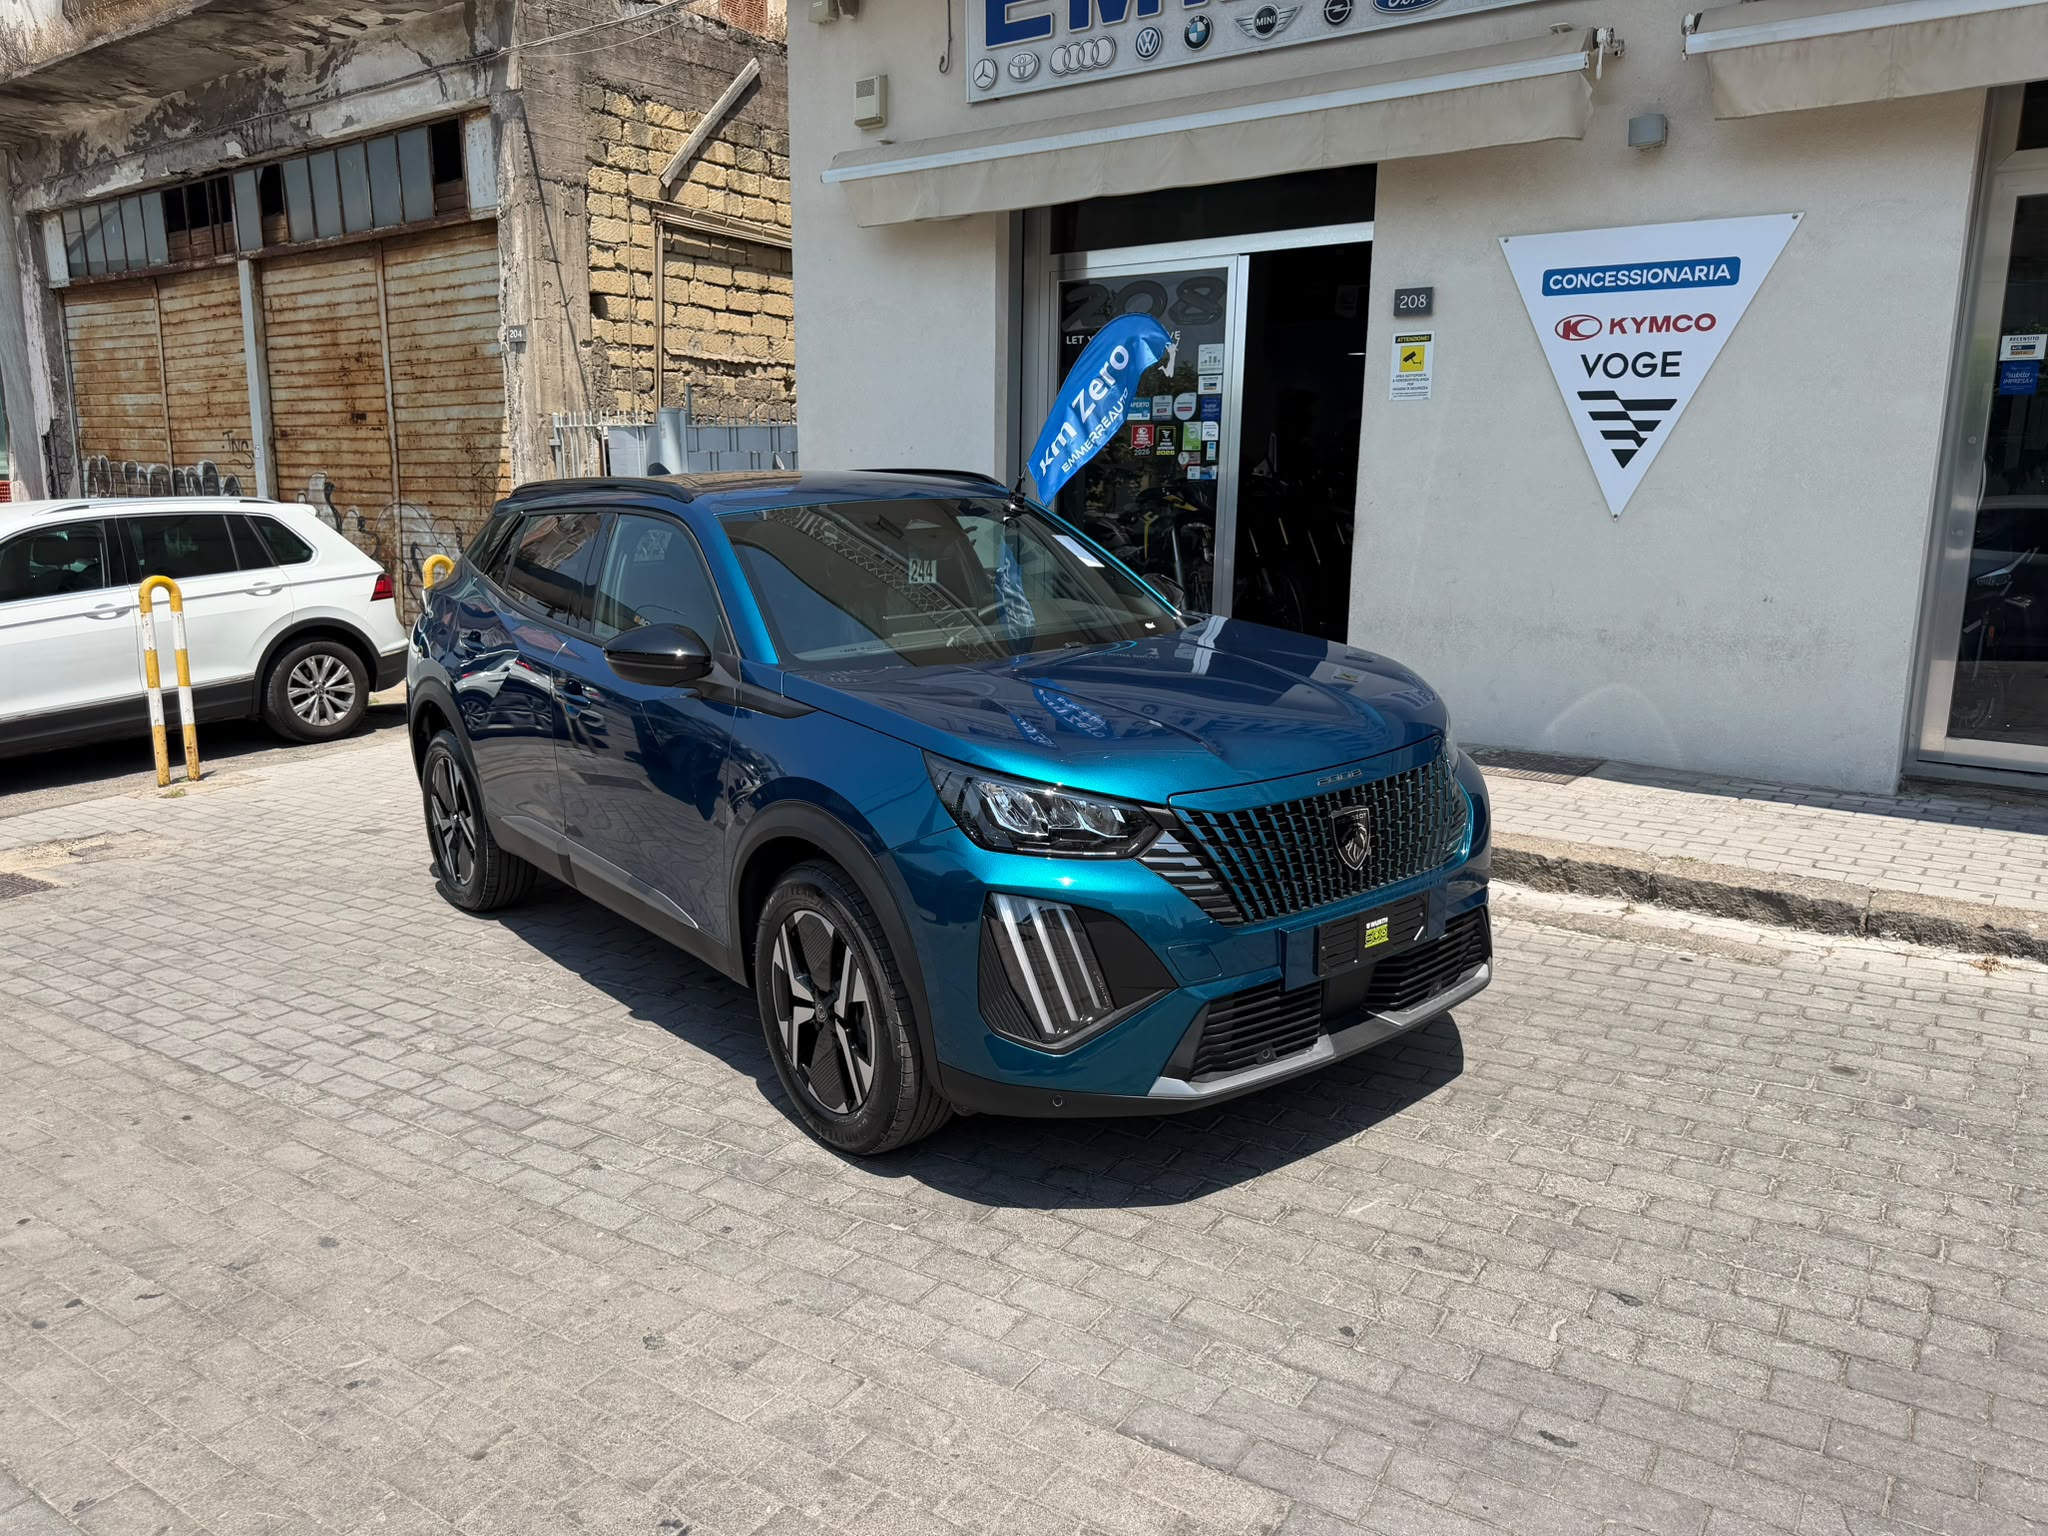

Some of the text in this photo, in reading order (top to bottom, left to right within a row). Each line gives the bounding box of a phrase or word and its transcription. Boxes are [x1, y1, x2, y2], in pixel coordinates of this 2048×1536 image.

[1255, 15, 1277, 27] MINI
[1549, 263, 1731, 290] CONCESSIONARIA
[1399, 294, 1427, 309] 208
[509, 329, 522, 338] 204
[1608, 312, 1717, 336] KYMCO
[1066, 335, 1084, 345] LET
[1580, 350, 1682, 379] VOGE
[1061, 387, 1129, 473] EMMERREAUTO
[910, 559, 933, 582] 244
